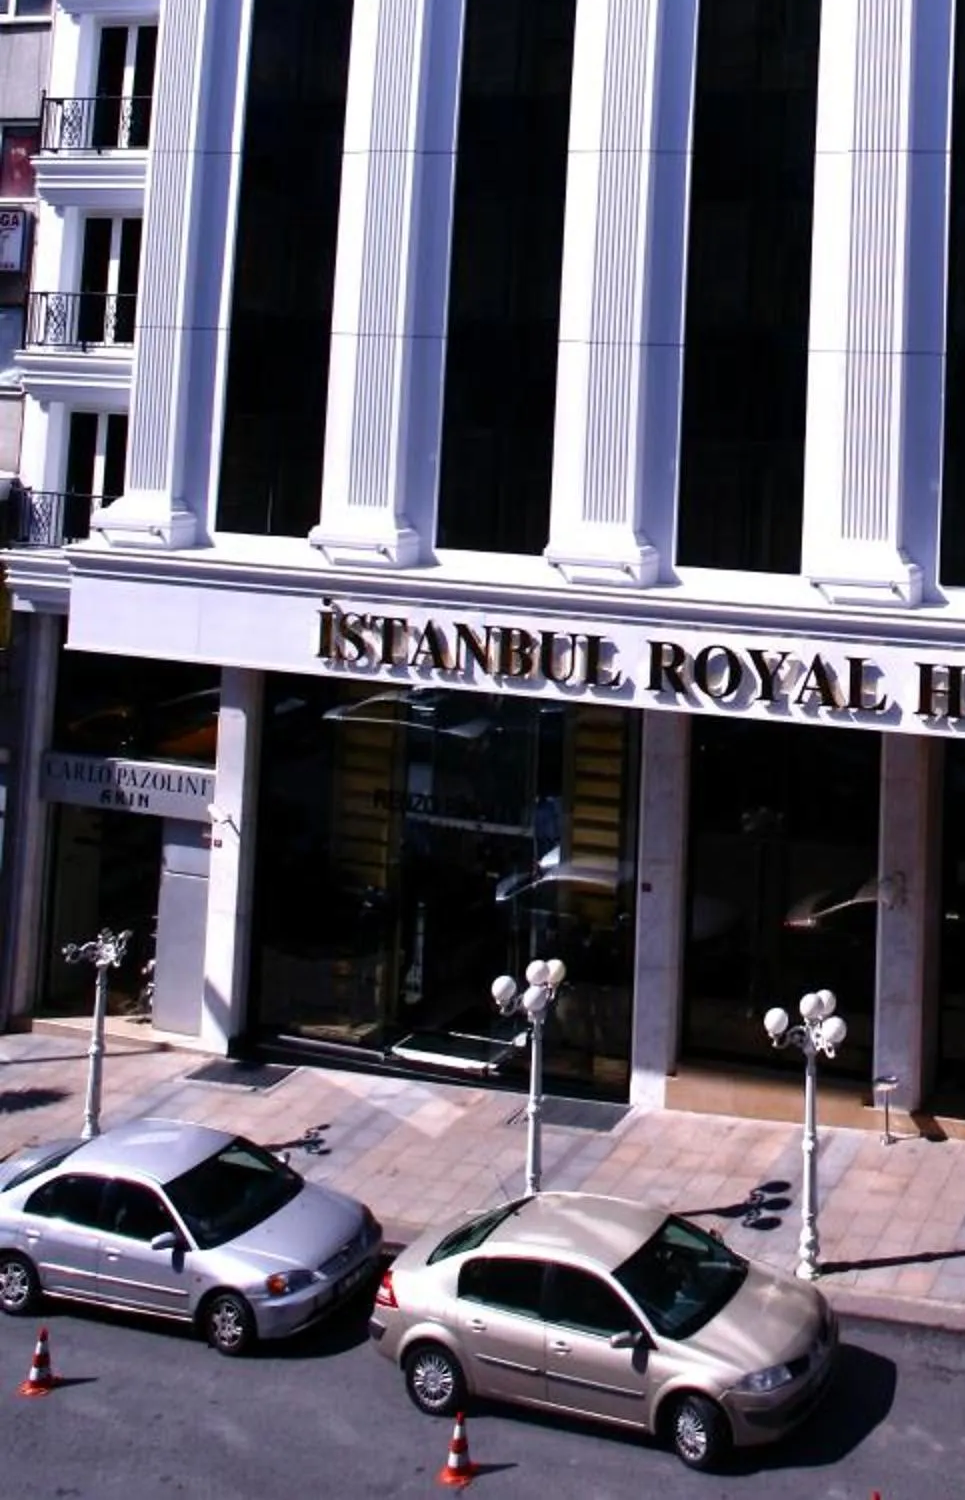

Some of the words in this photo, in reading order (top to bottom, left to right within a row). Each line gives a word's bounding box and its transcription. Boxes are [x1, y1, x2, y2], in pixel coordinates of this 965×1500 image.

[316, 597, 622, 687] İSTANBUL
[644, 639, 888, 711] ROYAL
[46, 760, 112, 784] CARLO
[115, 766, 209, 797] PAZOLINI
